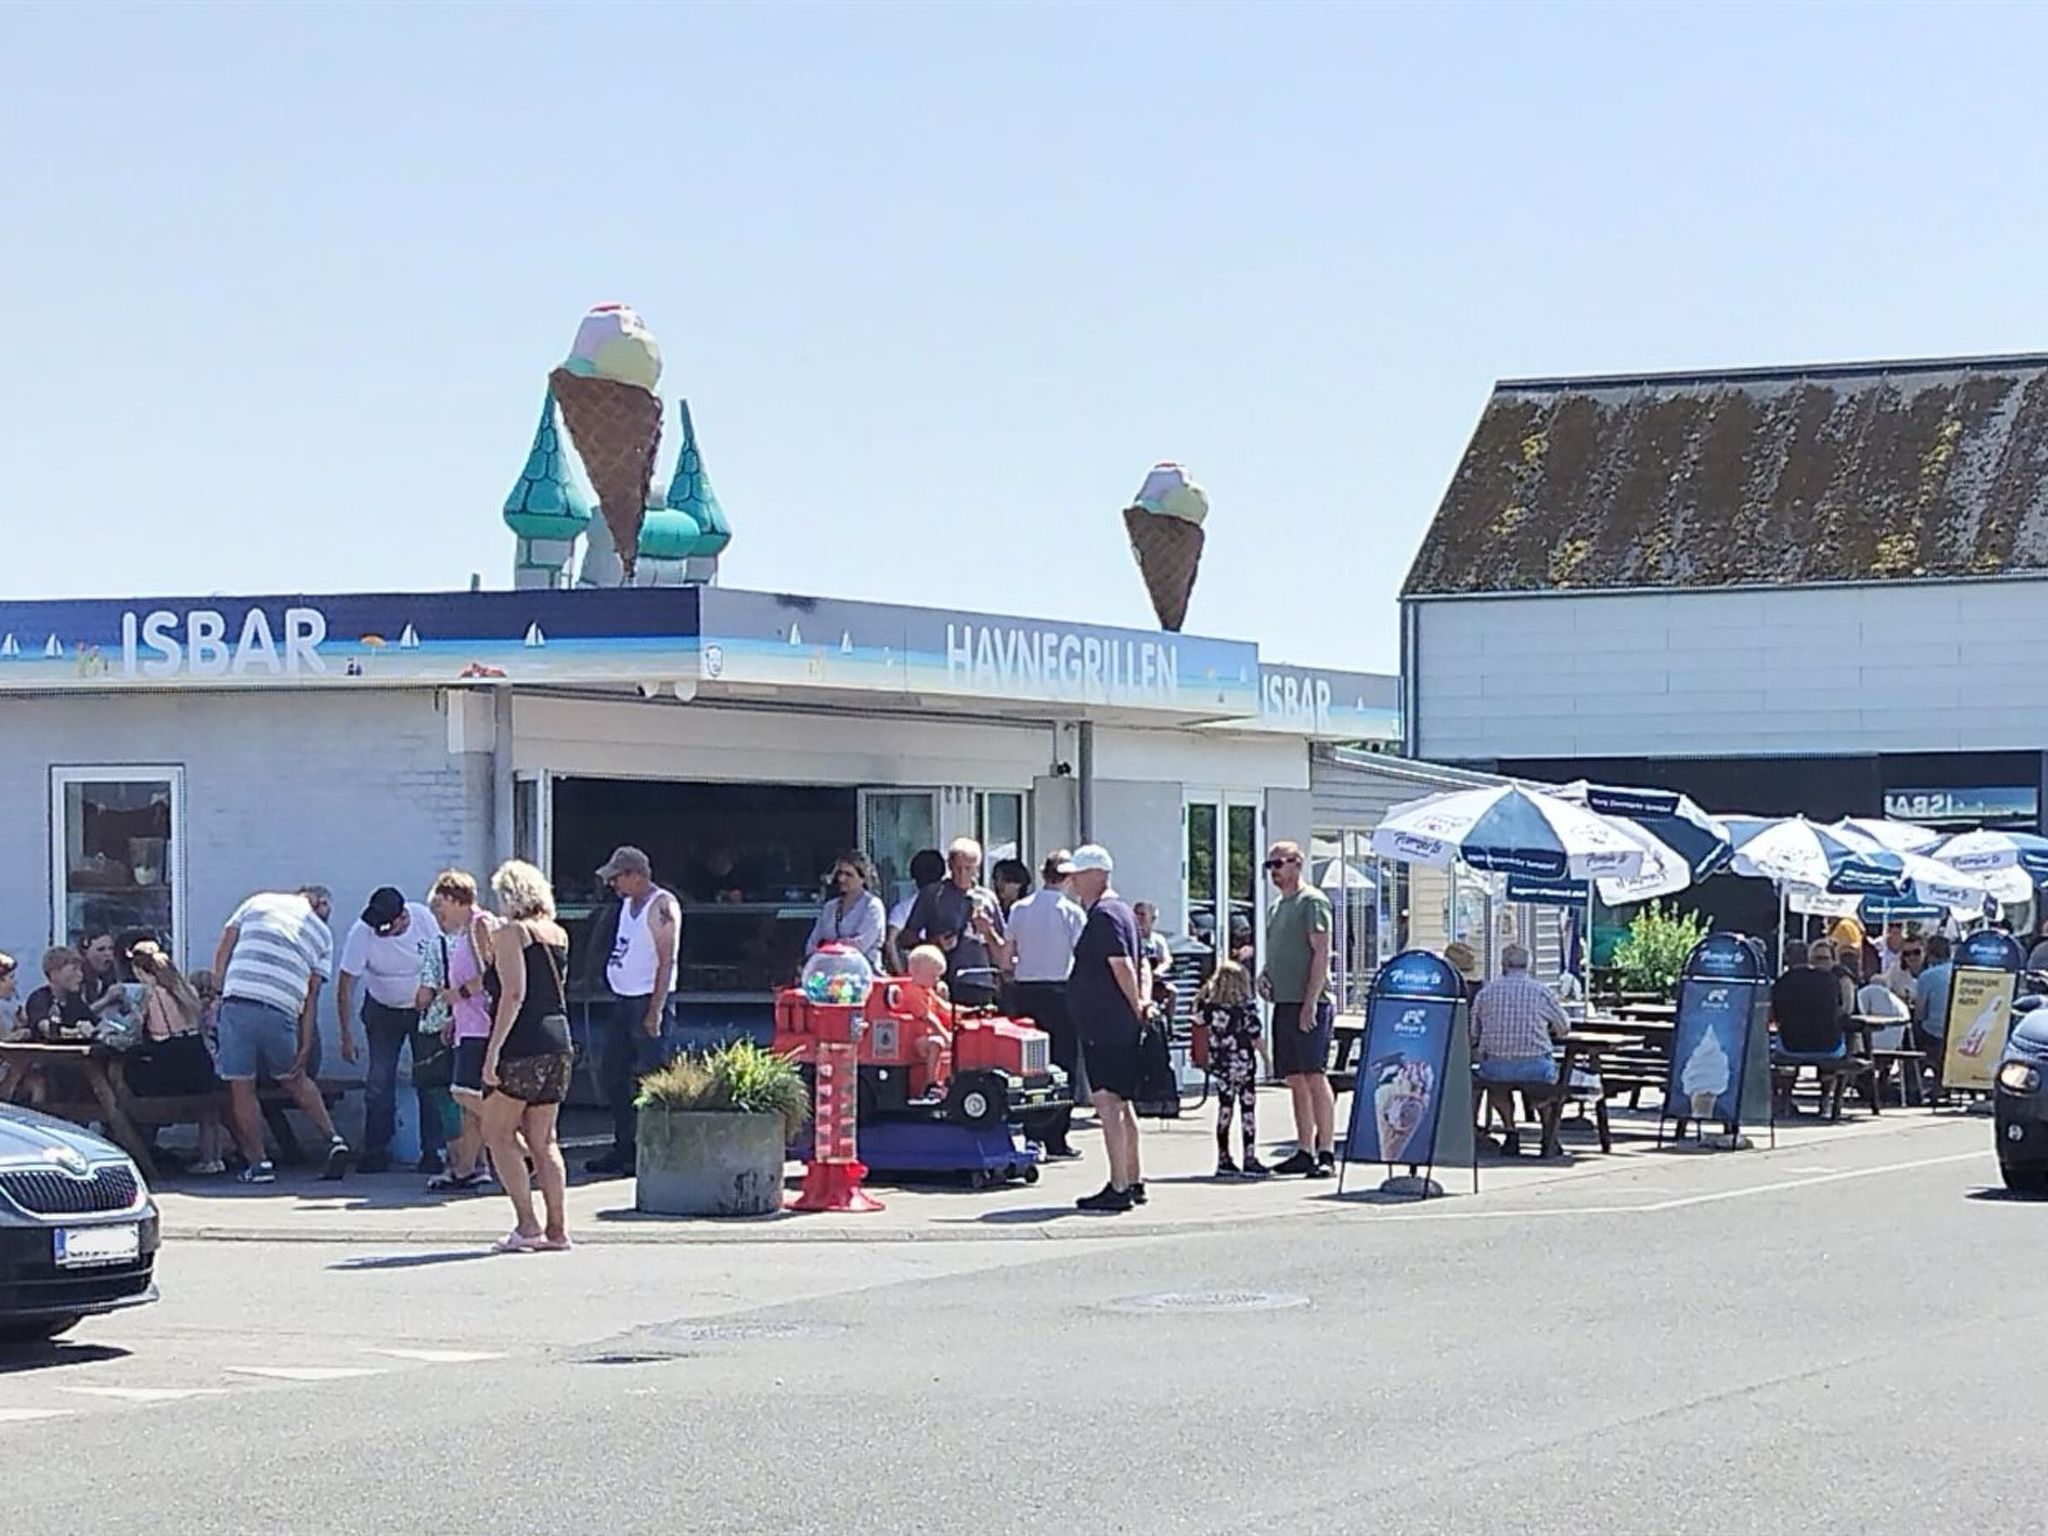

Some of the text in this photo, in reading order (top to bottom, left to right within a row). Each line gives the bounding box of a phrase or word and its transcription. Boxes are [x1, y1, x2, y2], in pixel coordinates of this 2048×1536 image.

[123, 607, 327, 677] ISBAR
[946, 623, 1177, 698] HAVNEGRILLEN
[1262, 674, 1331, 729] ISBAR
